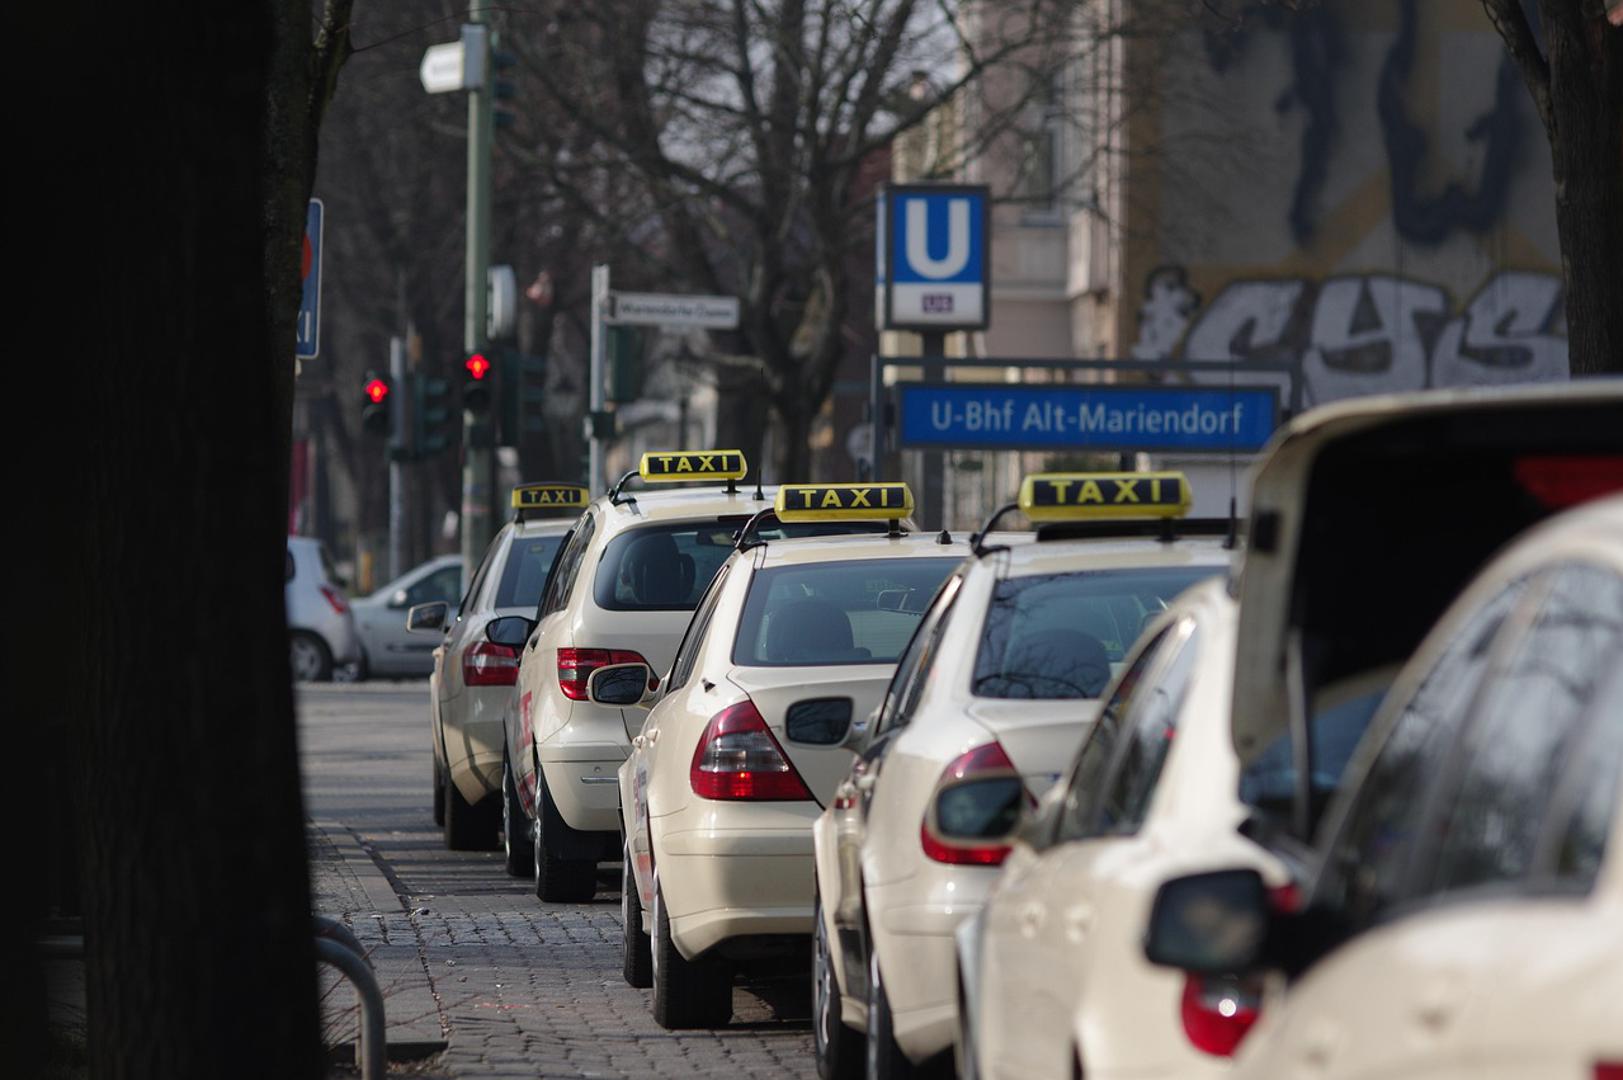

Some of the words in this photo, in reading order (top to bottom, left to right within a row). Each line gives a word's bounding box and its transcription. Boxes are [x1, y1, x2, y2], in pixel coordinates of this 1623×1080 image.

[905, 198, 970, 279] U
[931, 401, 1014, 431] U-Bhf
[1023, 402, 1243, 434] Alt-Mariendorf
[658, 456, 728, 472] TAXI
[529, 491, 574, 503] TAXI
[799, 489, 889, 507] TAXI
[1049, 480, 1162, 503] TAXI
